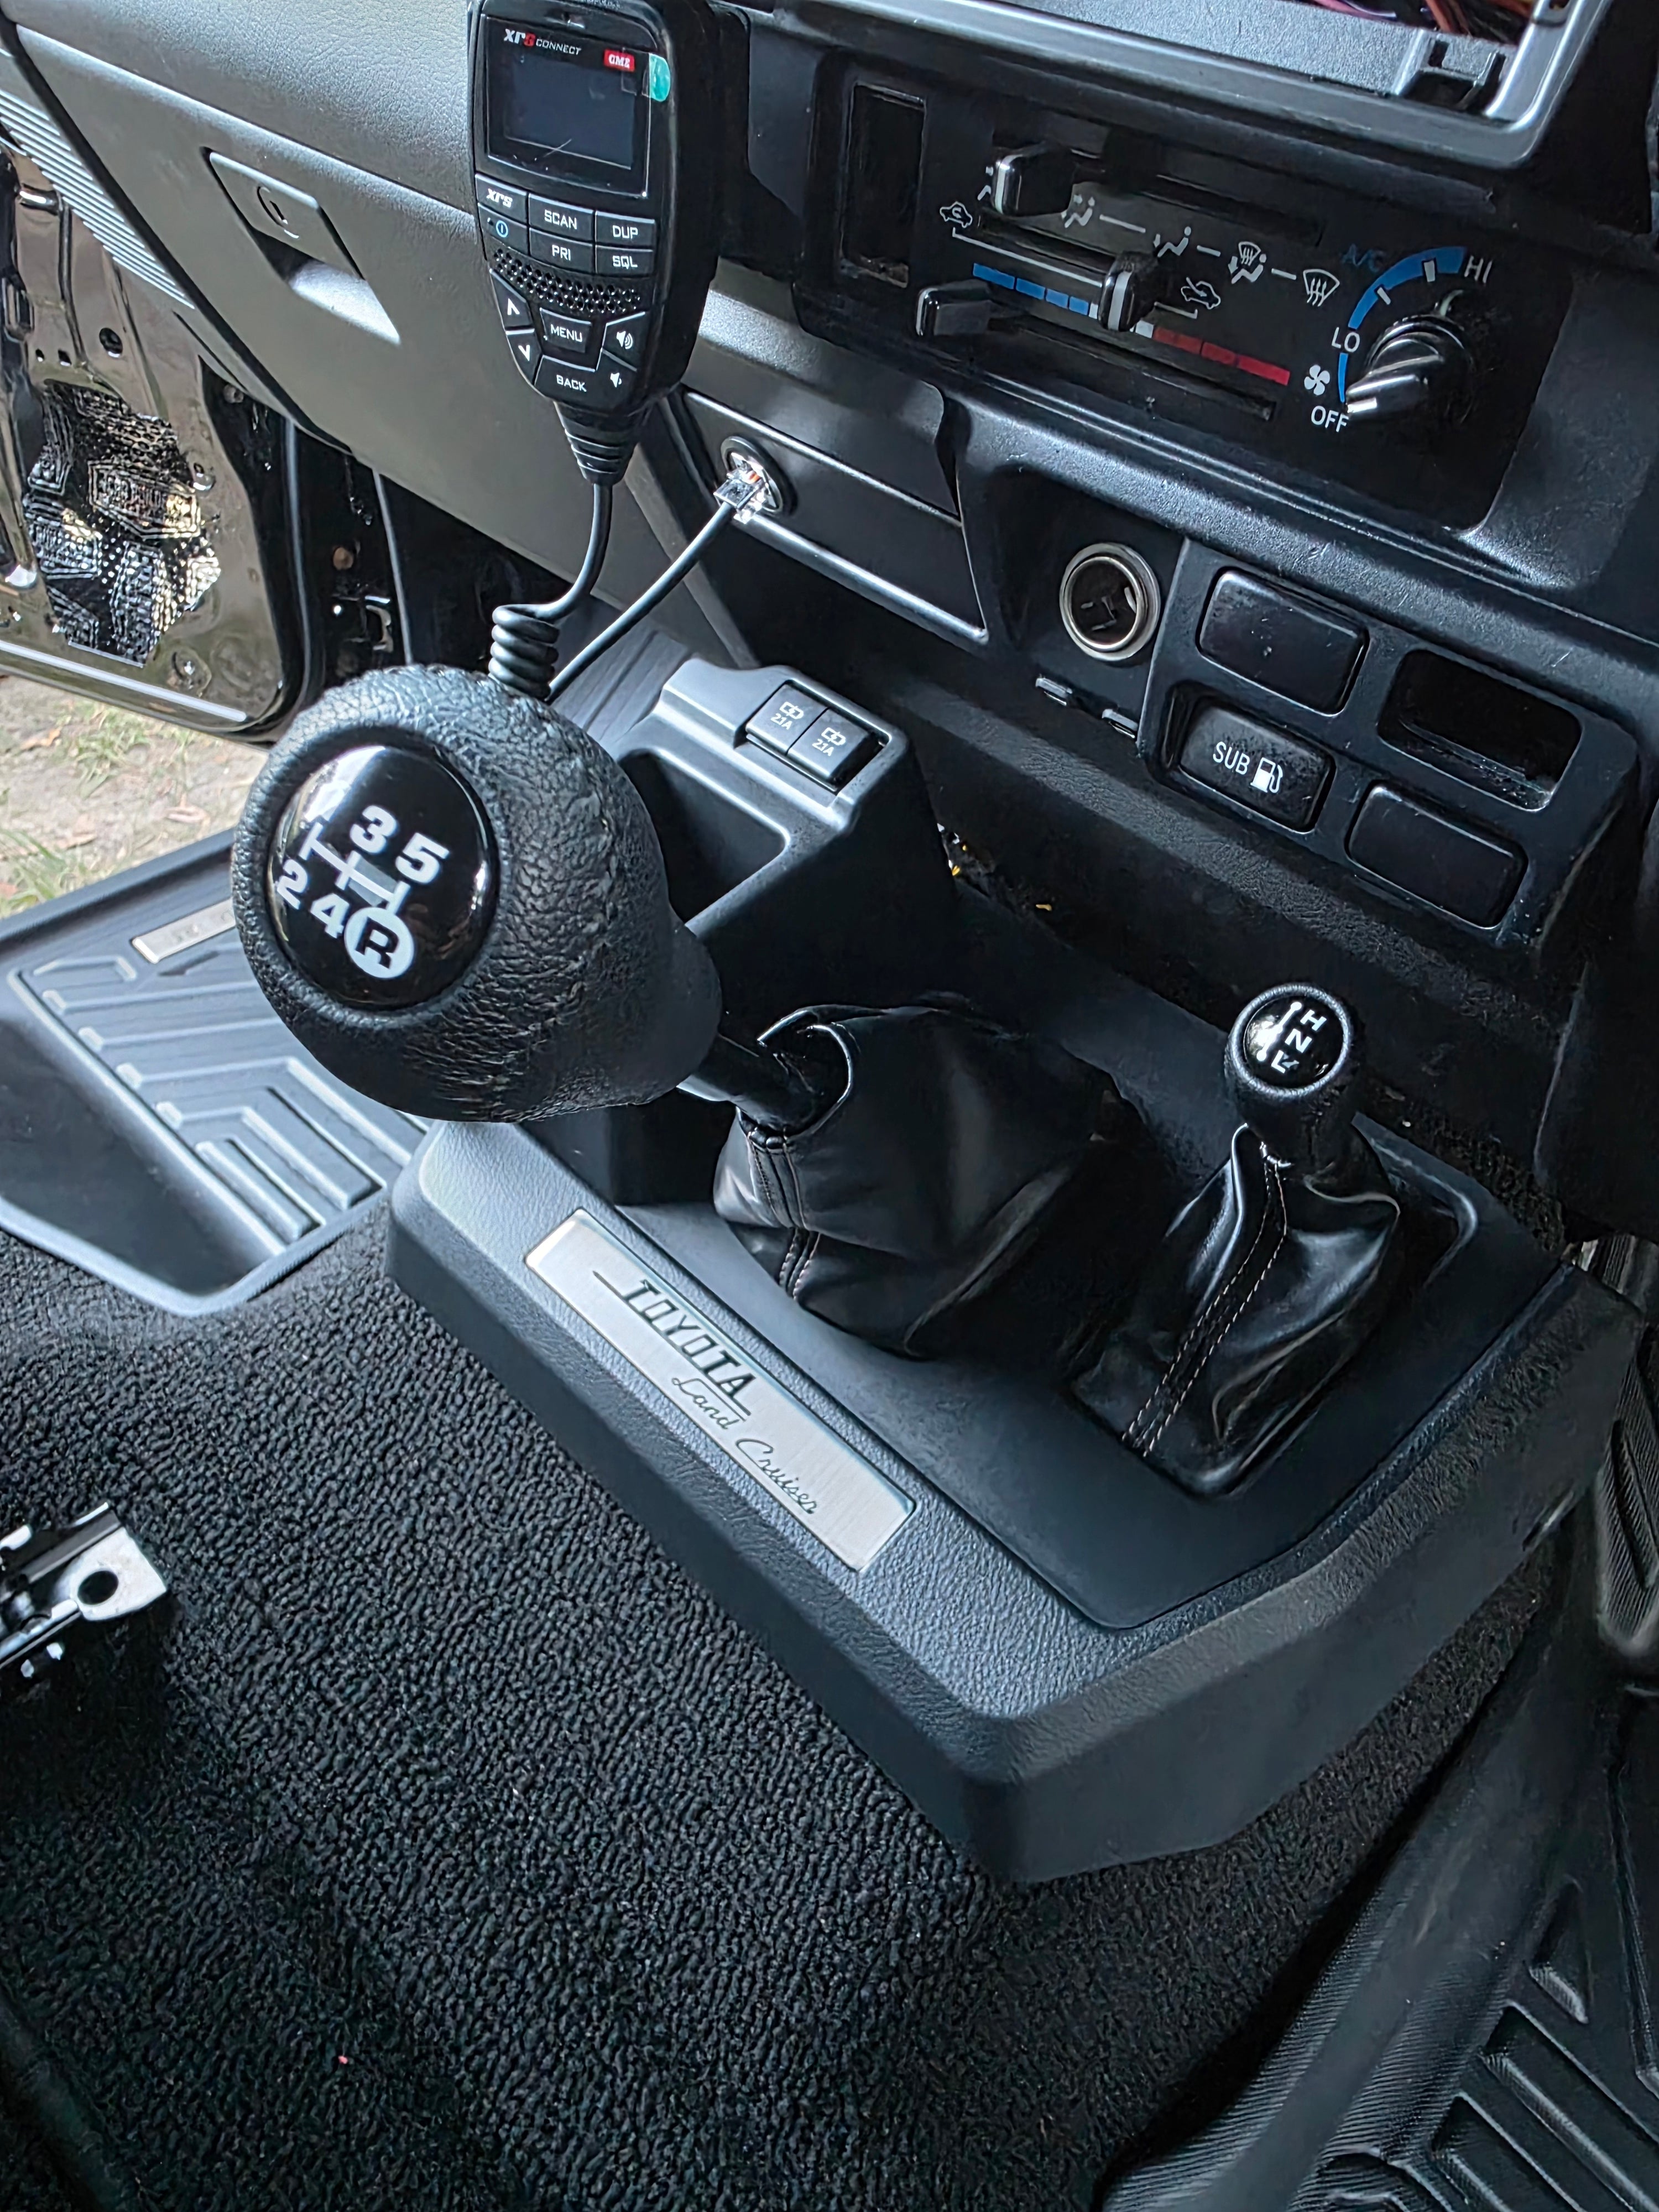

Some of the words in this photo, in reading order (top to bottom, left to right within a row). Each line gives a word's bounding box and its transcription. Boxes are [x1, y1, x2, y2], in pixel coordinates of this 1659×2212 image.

[535, 39, 582, 55] CONNECT
[544, 209, 577, 229] SCAN
[613, 225, 638, 239] DUP
[552, 244, 571, 261] PRI
[612, 255, 638, 269] SQL
[1342, 243, 1386, 273] A/C
[1464, 255, 1493, 284] HI
[550, 324, 583, 343] MENU
[1331, 326, 1360, 353] LO
[556, 374, 587, 392] BACK
[1311, 405, 1349, 432] OFF
[1213, 741, 1250, 775] SUB
[349, 805, 397, 854] 3
[395, 832, 450, 884] 5
[274, 859, 308, 910] 2
[310, 893, 351, 939] 4
[354, 917, 400, 969] R
[1300, 1009, 1327, 1031] H
[1284, 1028, 1312, 1053] N
[1271, 1050, 1286, 1074] L
[603, 1274, 757, 1410] TOYOTA
[671, 1377, 744, 1431] Land
[735, 1438, 820, 1516] Cruiser
